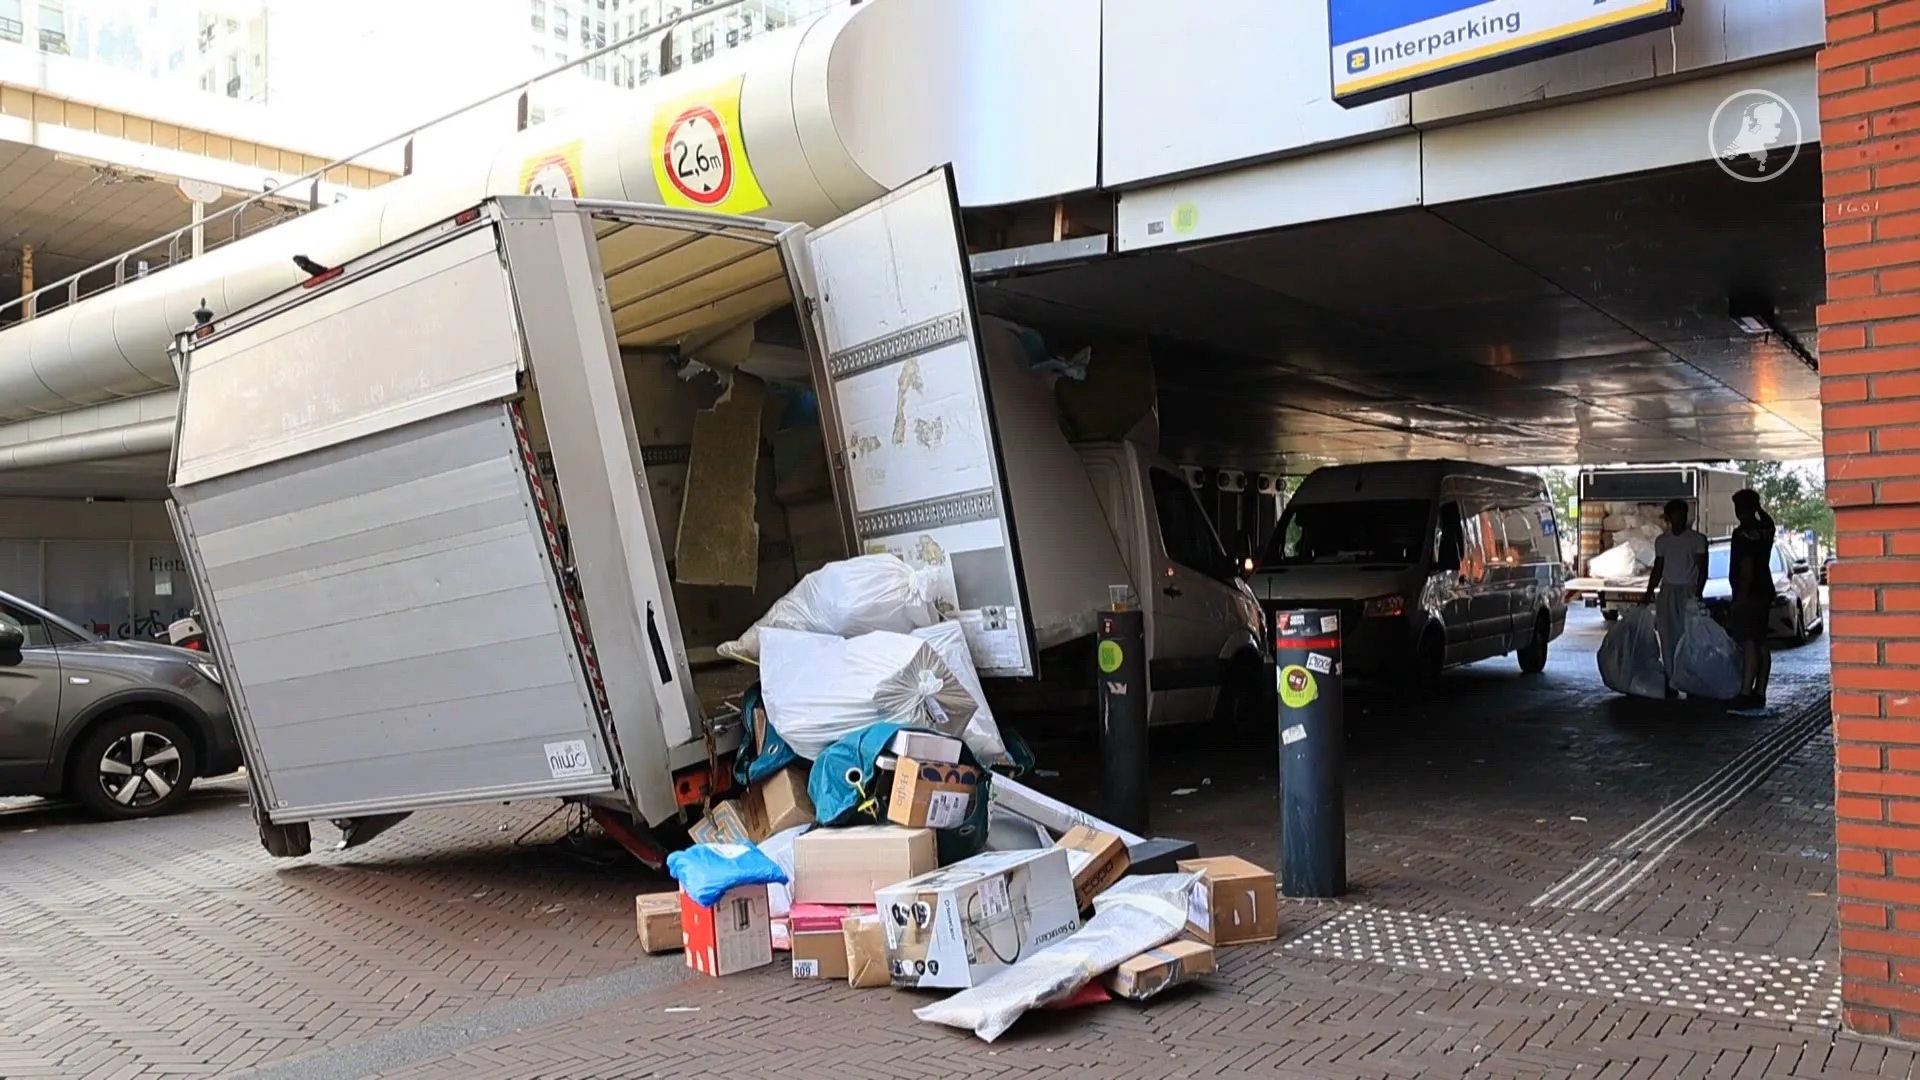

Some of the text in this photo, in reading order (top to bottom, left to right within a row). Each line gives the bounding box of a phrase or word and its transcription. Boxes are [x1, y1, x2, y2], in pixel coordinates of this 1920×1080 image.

[1374, 12, 1521, 65] Interparking
[550, 752, 588, 770] niwo
[794, 966, 811, 977] 309
